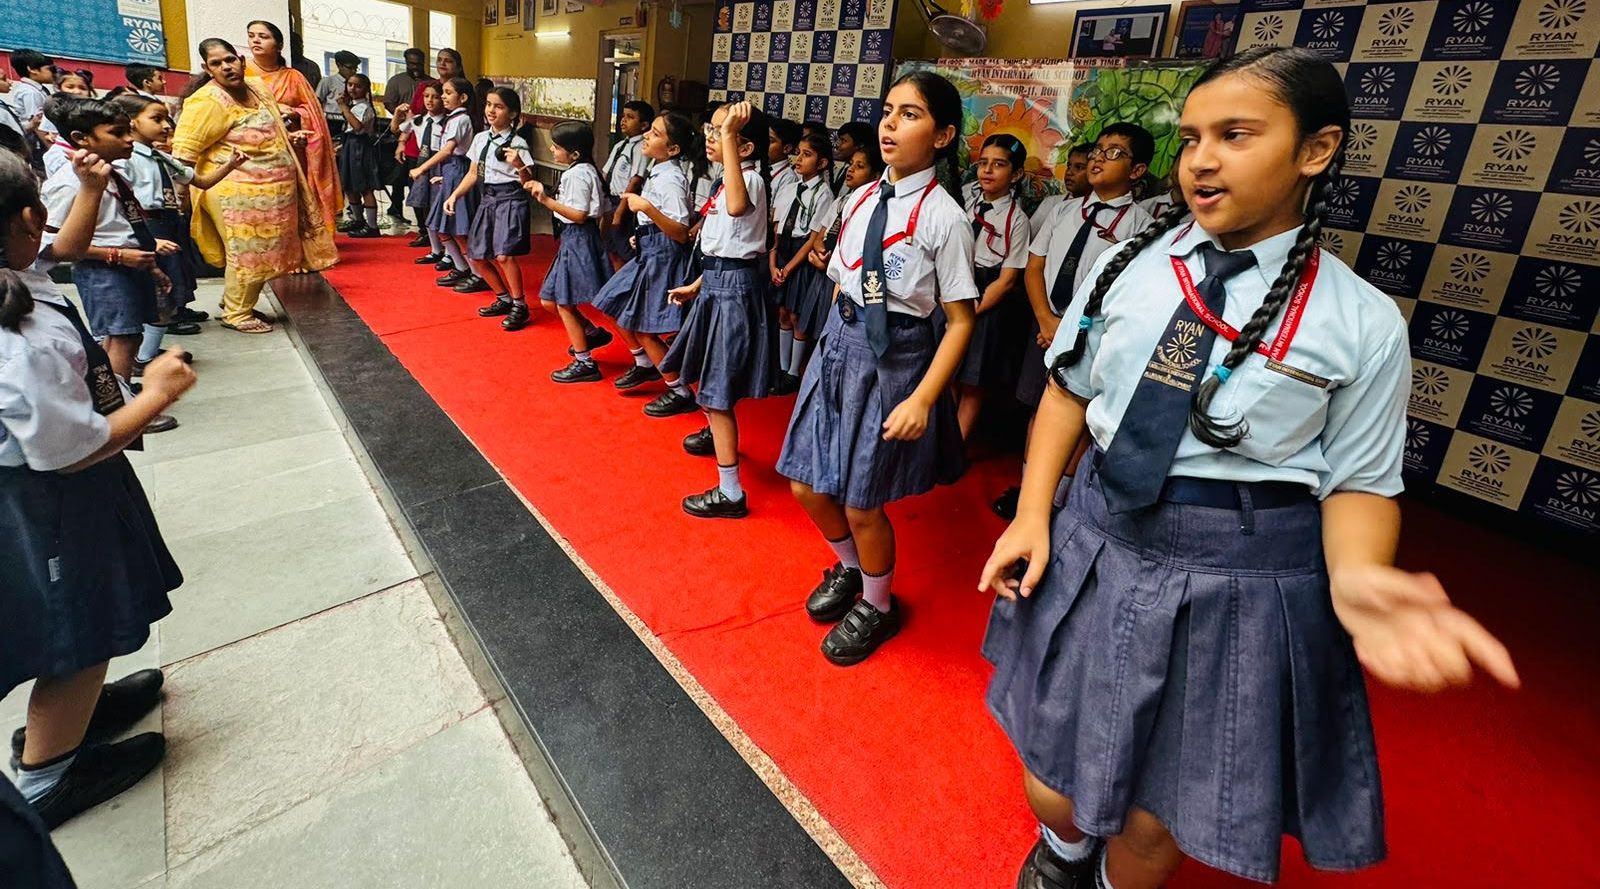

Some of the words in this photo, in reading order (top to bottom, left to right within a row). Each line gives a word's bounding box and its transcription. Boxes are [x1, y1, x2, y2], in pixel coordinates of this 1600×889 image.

[123, 17, 163, 32] RYAN
[1371, 38, 1408, 46] RYAN
[1445, 35, 1486, 44] RYAN
[1530, 31, 1577, 41] RYAN
[971, 69, 990, 79] RYAN
[1054, 69, 1087, 80] SCHOOL
[1354, 96, 1389, 104] RYAN
[1425, 97, 1465, 106] RYAN
[1507, 99, 1552, 108] RYAN
[1406, 156, 1445, 167] RYAN
[1484, 162, 1528, 172] RYAN
[1387, 213, 1425, 225] RYAN
[1463, 223, 1505, 235] RYAN
[1550, 233, 1598, 246] RYAN
[1370, 269, 1406, 281] RYAN
[1443, 281, 1484, 295] RYAN
[1183, 276, 1205, 315] INTERNATIONAL
[1203, 312, 1230, 333] SCHOOL
[1526, 296, 1573, 311] RYAN
[1276, 306, 1300, 349] INTERNATIONAL
[1293, 281, 1309, 307] SCHOOL
[1174, 319, 1205, 337] RYAN
[1423, 338, 1463, 353] RYAN
[1503, 356, 1549, 373] RYAN
[1482, 413, 1526, 432] RYAN
[1461, 469, 1504, 489] RYAN
[1548, 497, 1595, 519] RYAN
